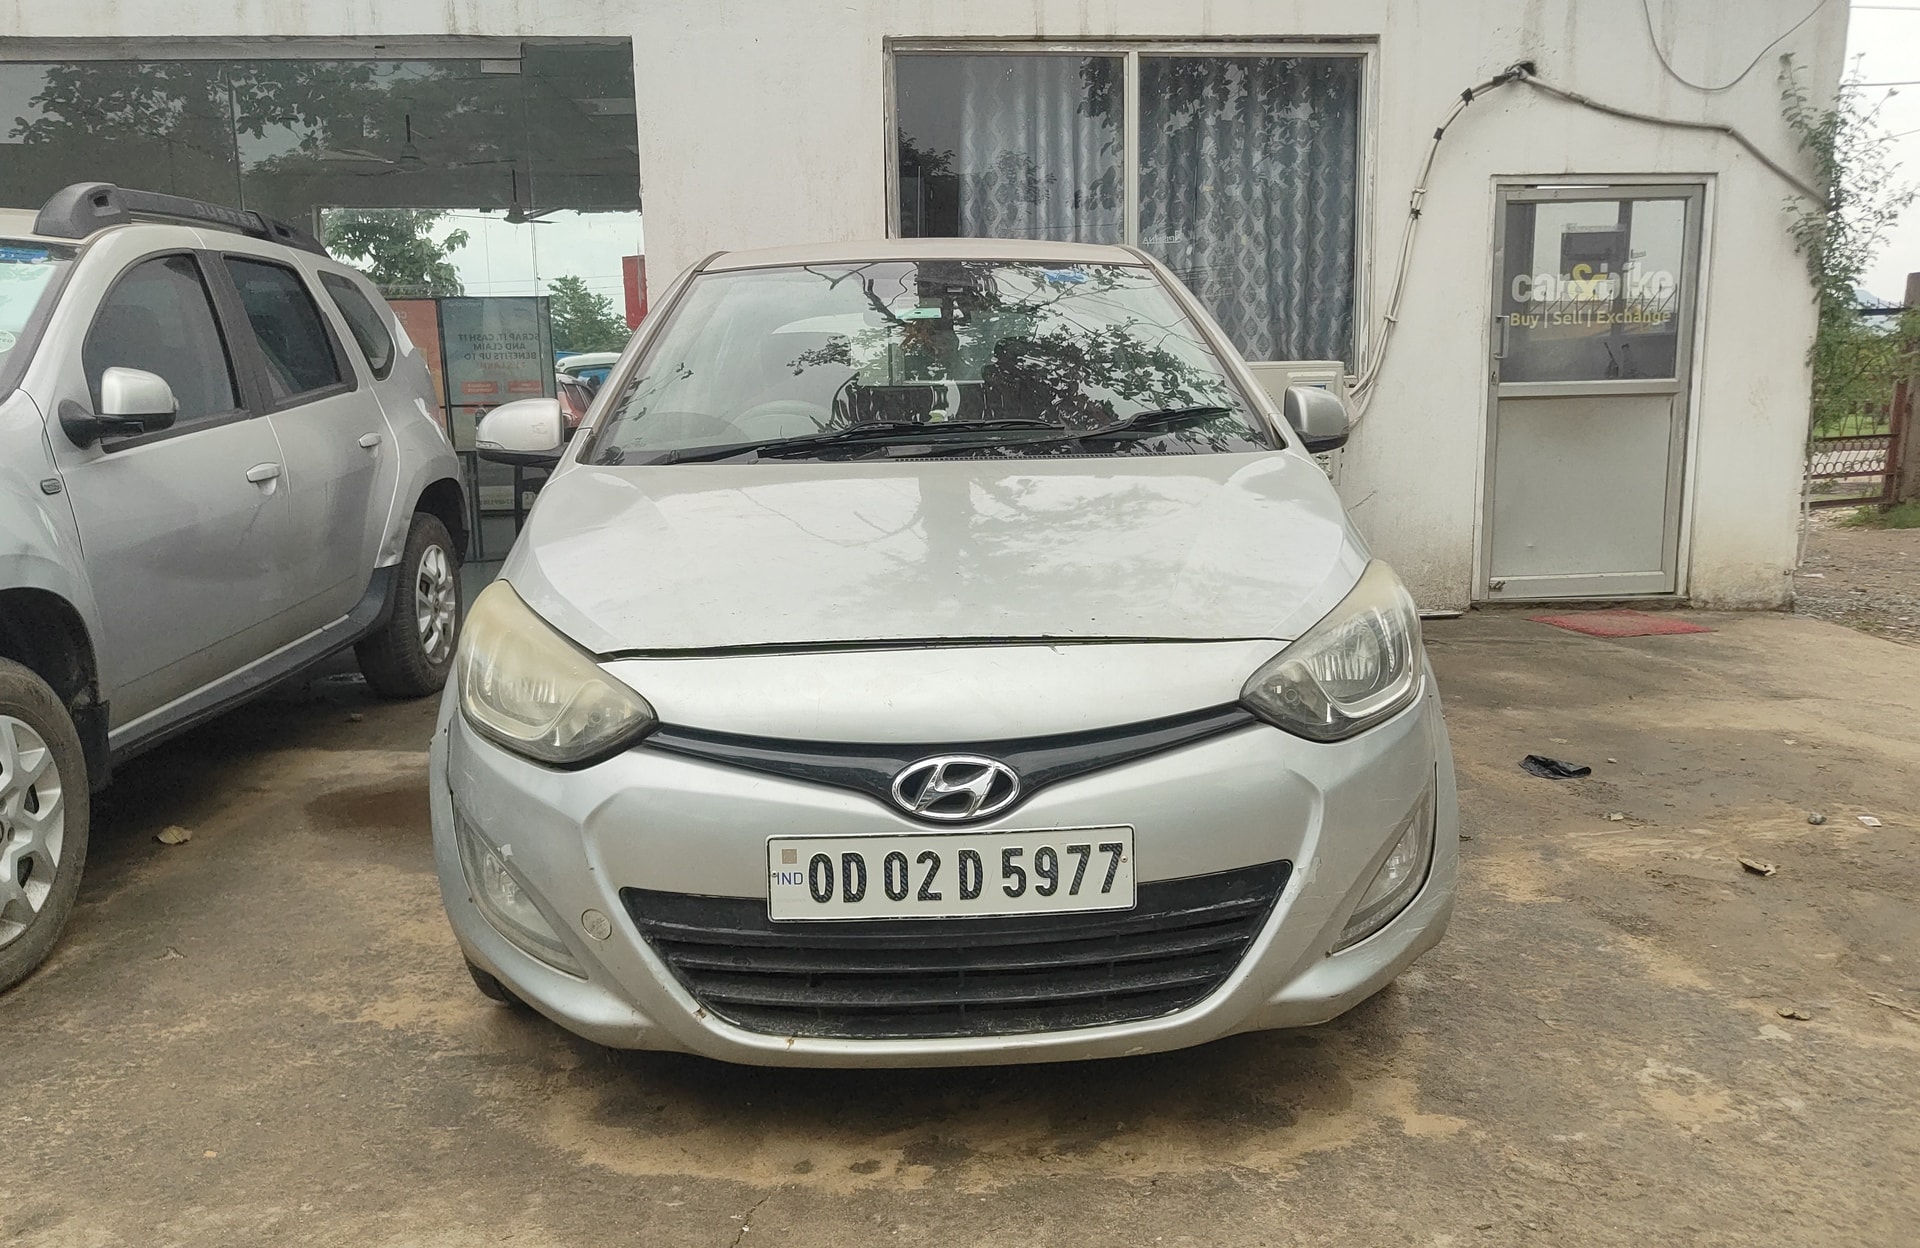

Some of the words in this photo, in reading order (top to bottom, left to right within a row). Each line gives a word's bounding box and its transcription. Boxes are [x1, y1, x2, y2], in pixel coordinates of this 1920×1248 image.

[193, 202, 259, 228] DUSTER
[1510, 312, 1539, 328] Buy
[1553, 310, 1582, 325] Sell
[1596, 308, 1671, 326] Exchange
[776, 871, 804, 886] IND
[808, 851, 867, 904] OD
[883, 850, 942, 902] 02
[959, 849, 984, 901] D
[1002, 842, 1124, 898] 5977
